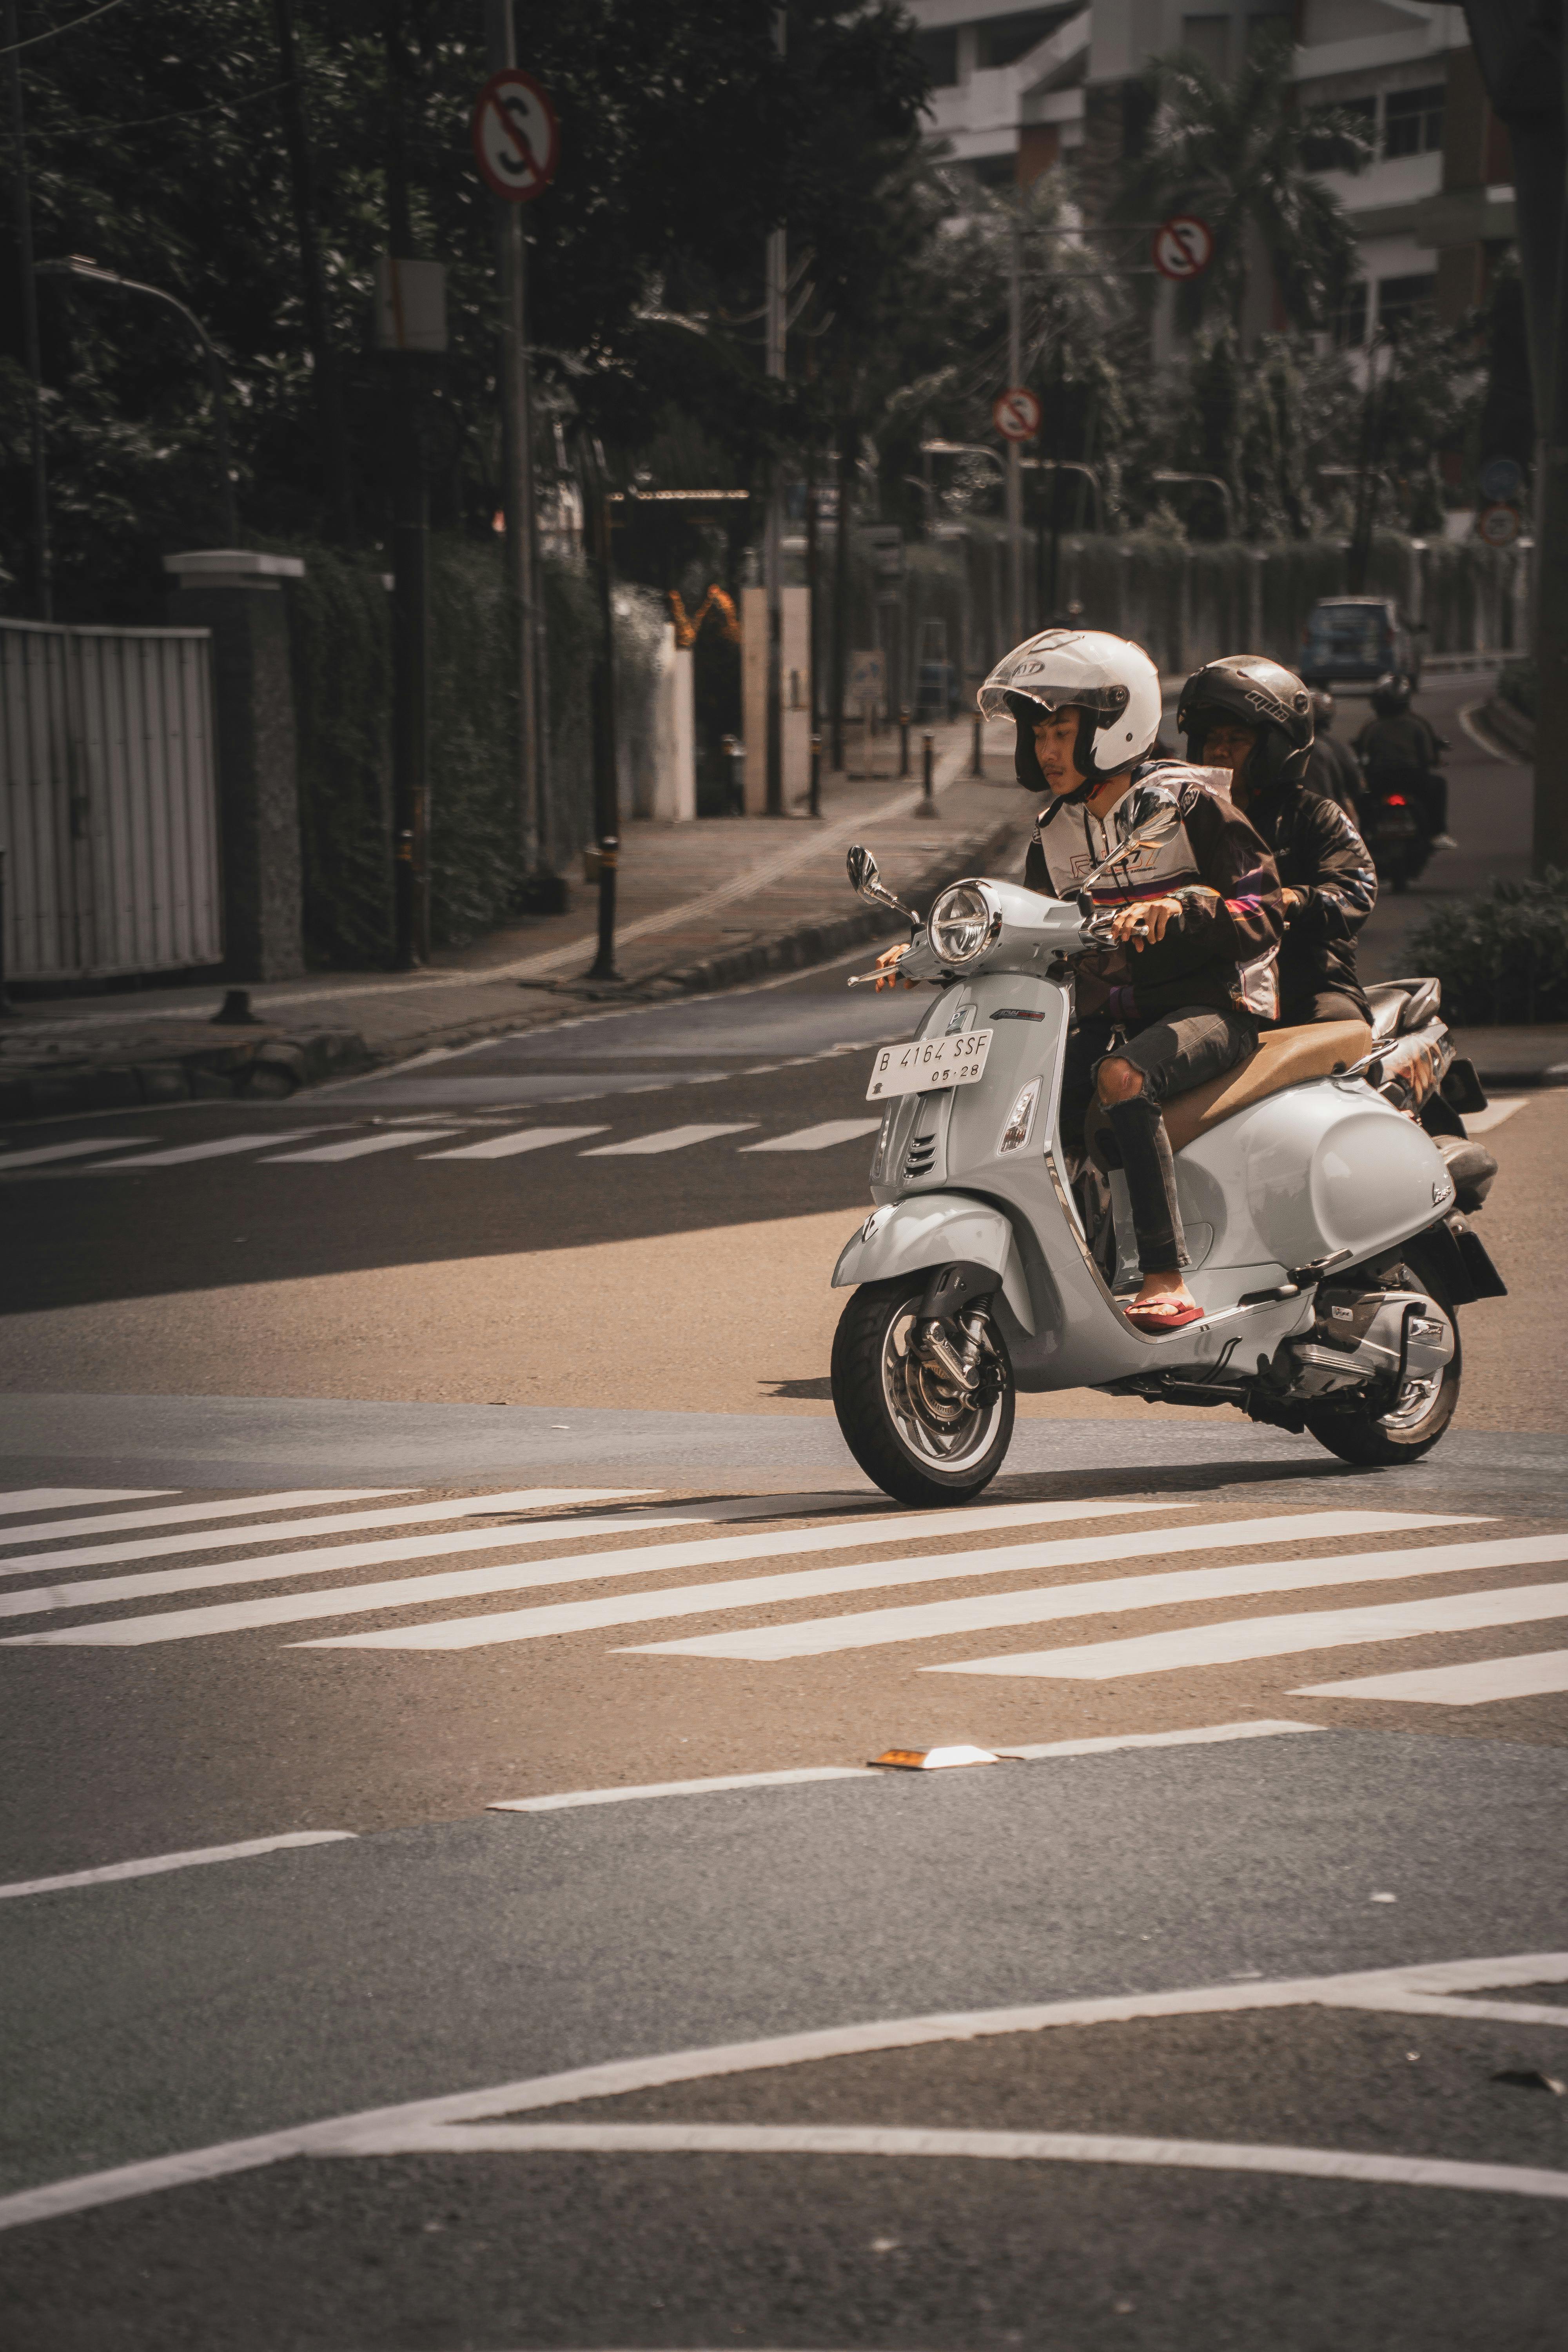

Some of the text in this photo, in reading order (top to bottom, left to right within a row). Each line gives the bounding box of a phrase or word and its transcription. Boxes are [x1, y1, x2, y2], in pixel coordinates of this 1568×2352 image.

[880, 1035, 987, 1071] B 4164 SSF
